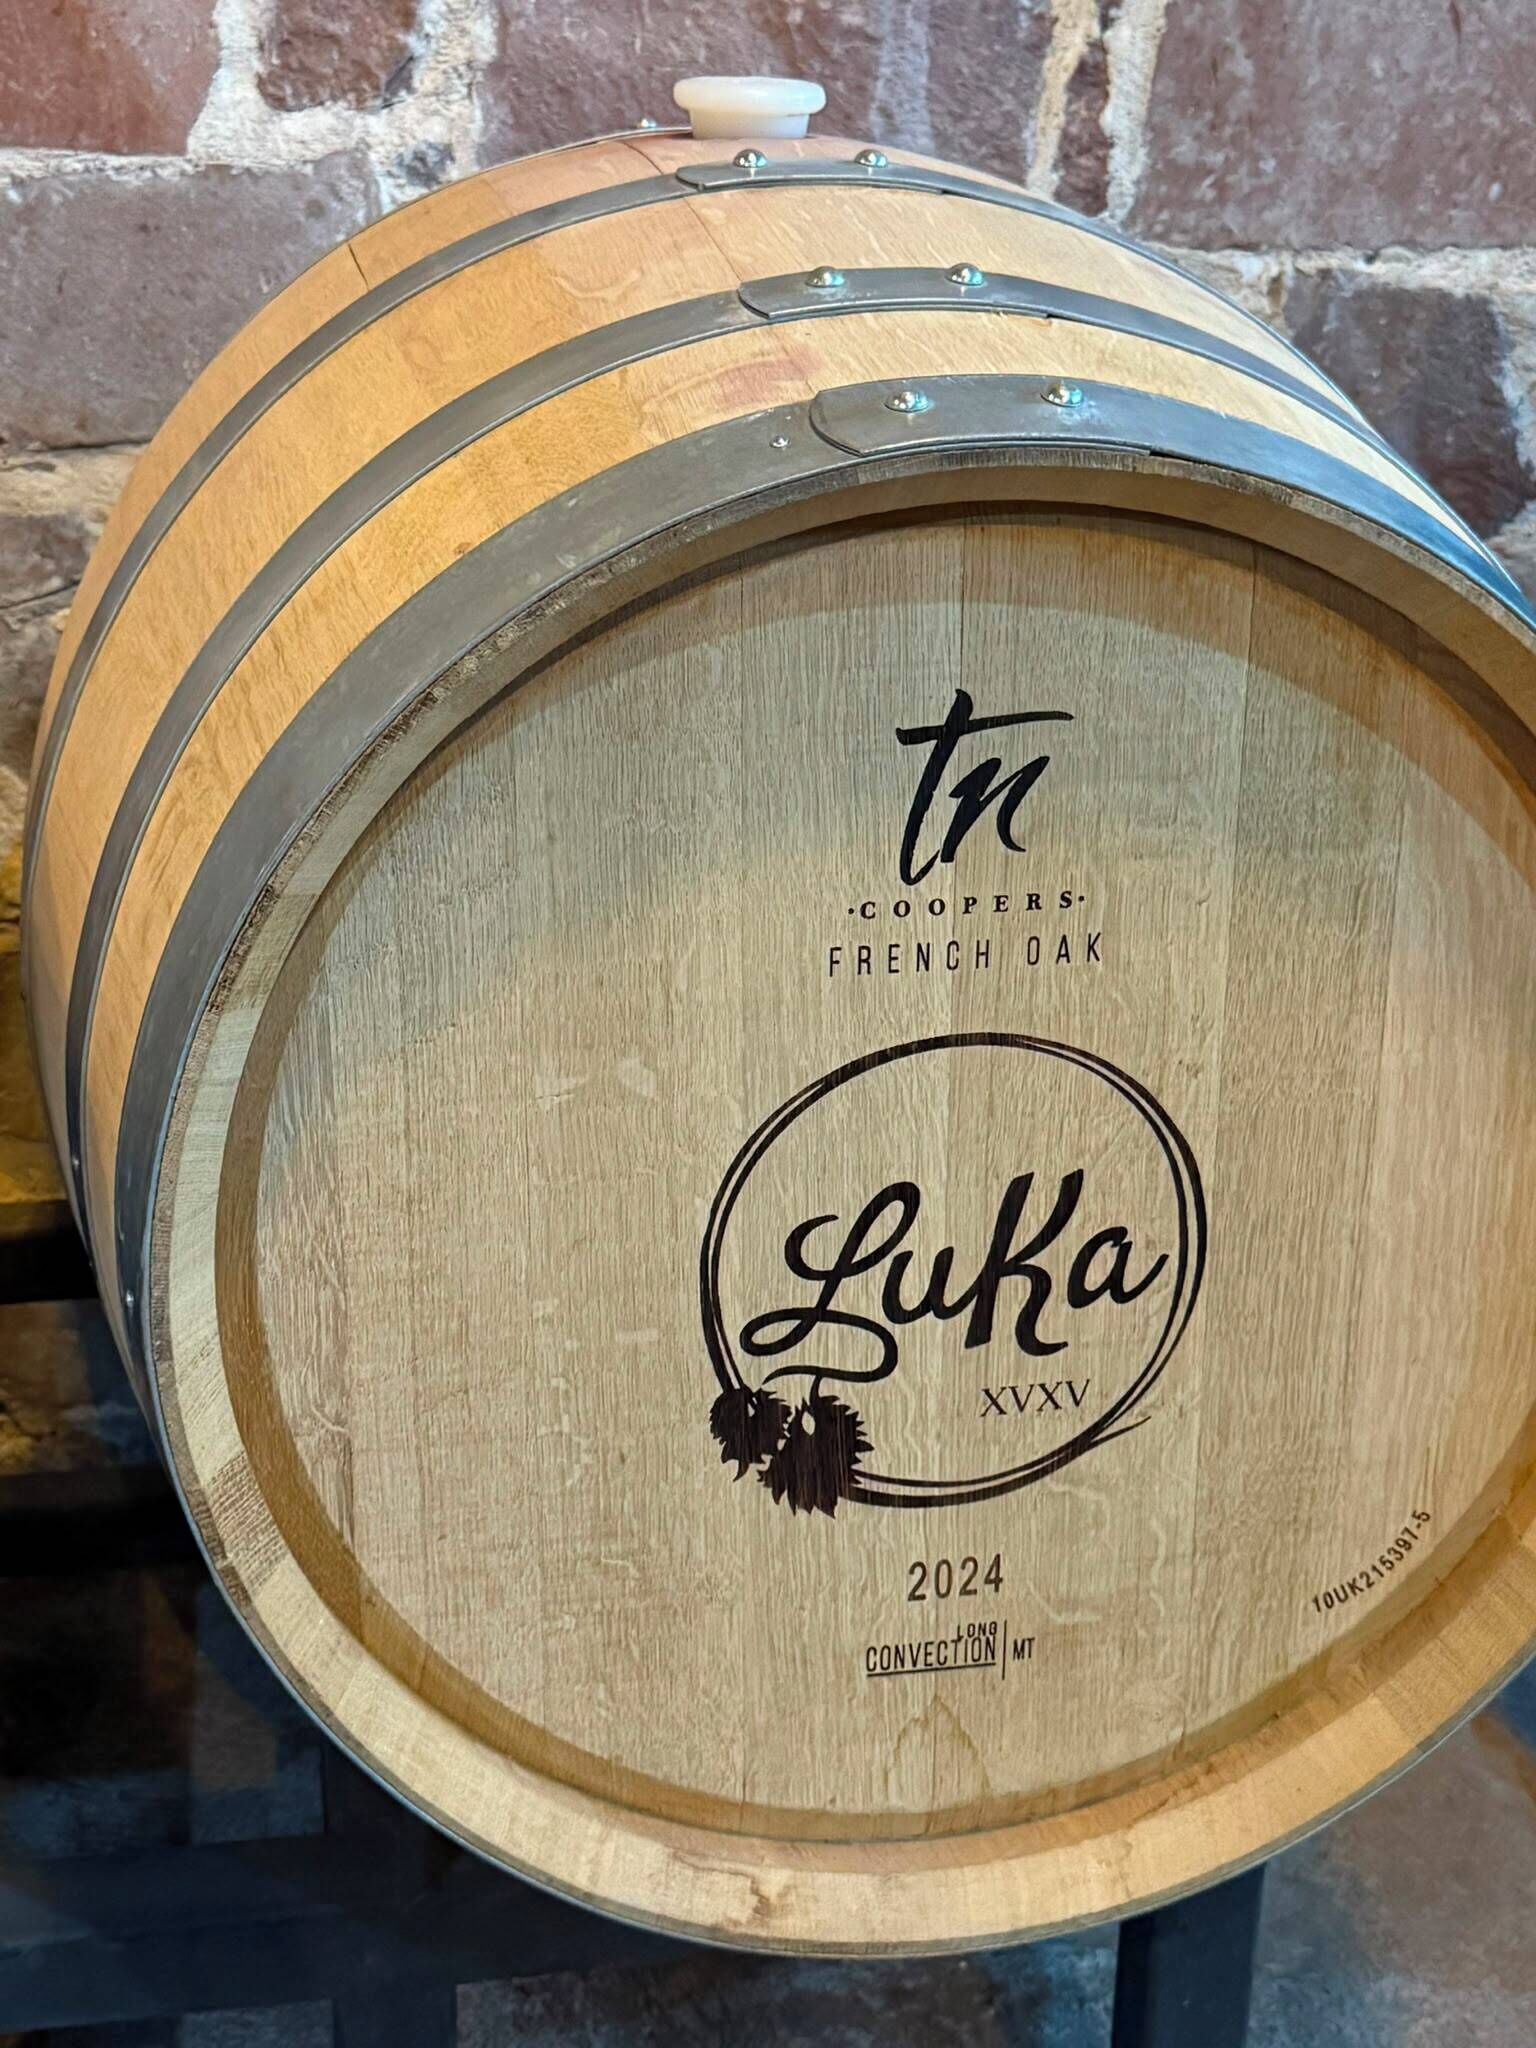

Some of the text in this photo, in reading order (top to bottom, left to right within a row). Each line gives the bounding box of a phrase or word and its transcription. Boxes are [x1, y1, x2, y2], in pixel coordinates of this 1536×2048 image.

[829, 932, 1102, 977] FRENCH OAK
[979, 1378, 1090, 1418] XVXV
[907, 1553, 1004, 1602] 2024
[956, 1621, 998, 1639] LONG
[865, 1636, 1036, 1673] CONVECTION MT
